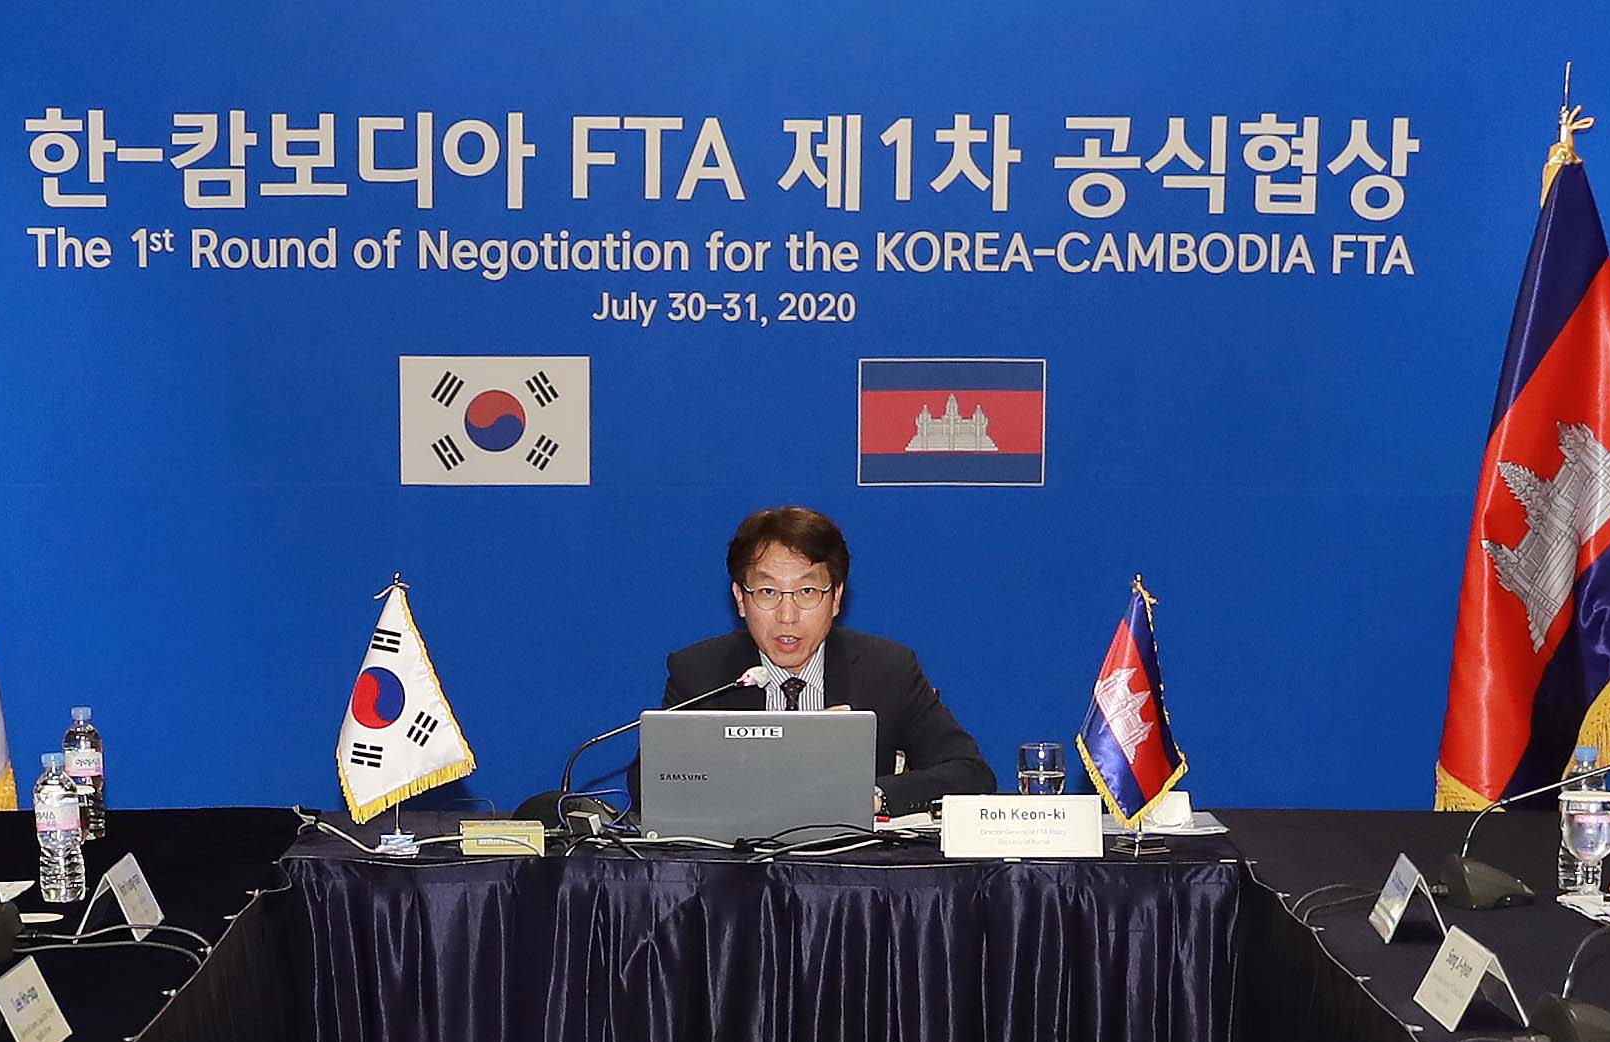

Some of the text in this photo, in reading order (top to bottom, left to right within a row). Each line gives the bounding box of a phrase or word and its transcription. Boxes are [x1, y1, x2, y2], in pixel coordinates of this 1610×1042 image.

[25, 107, 1419, 220] 한-캄보디아 FTA 제1차 공식협상
[27, 227, 1414, 280] The 1st Round of Negotiation for the KOREA-CAMBODIA FTA
[593, 292, 855, 327] July 30-31, 2020
[728, 727, 780, 737] LOTTE
[659, 772, 709, 782] SAMSUNG
[980, 807, 1066, 820] Roh Keon-ki
